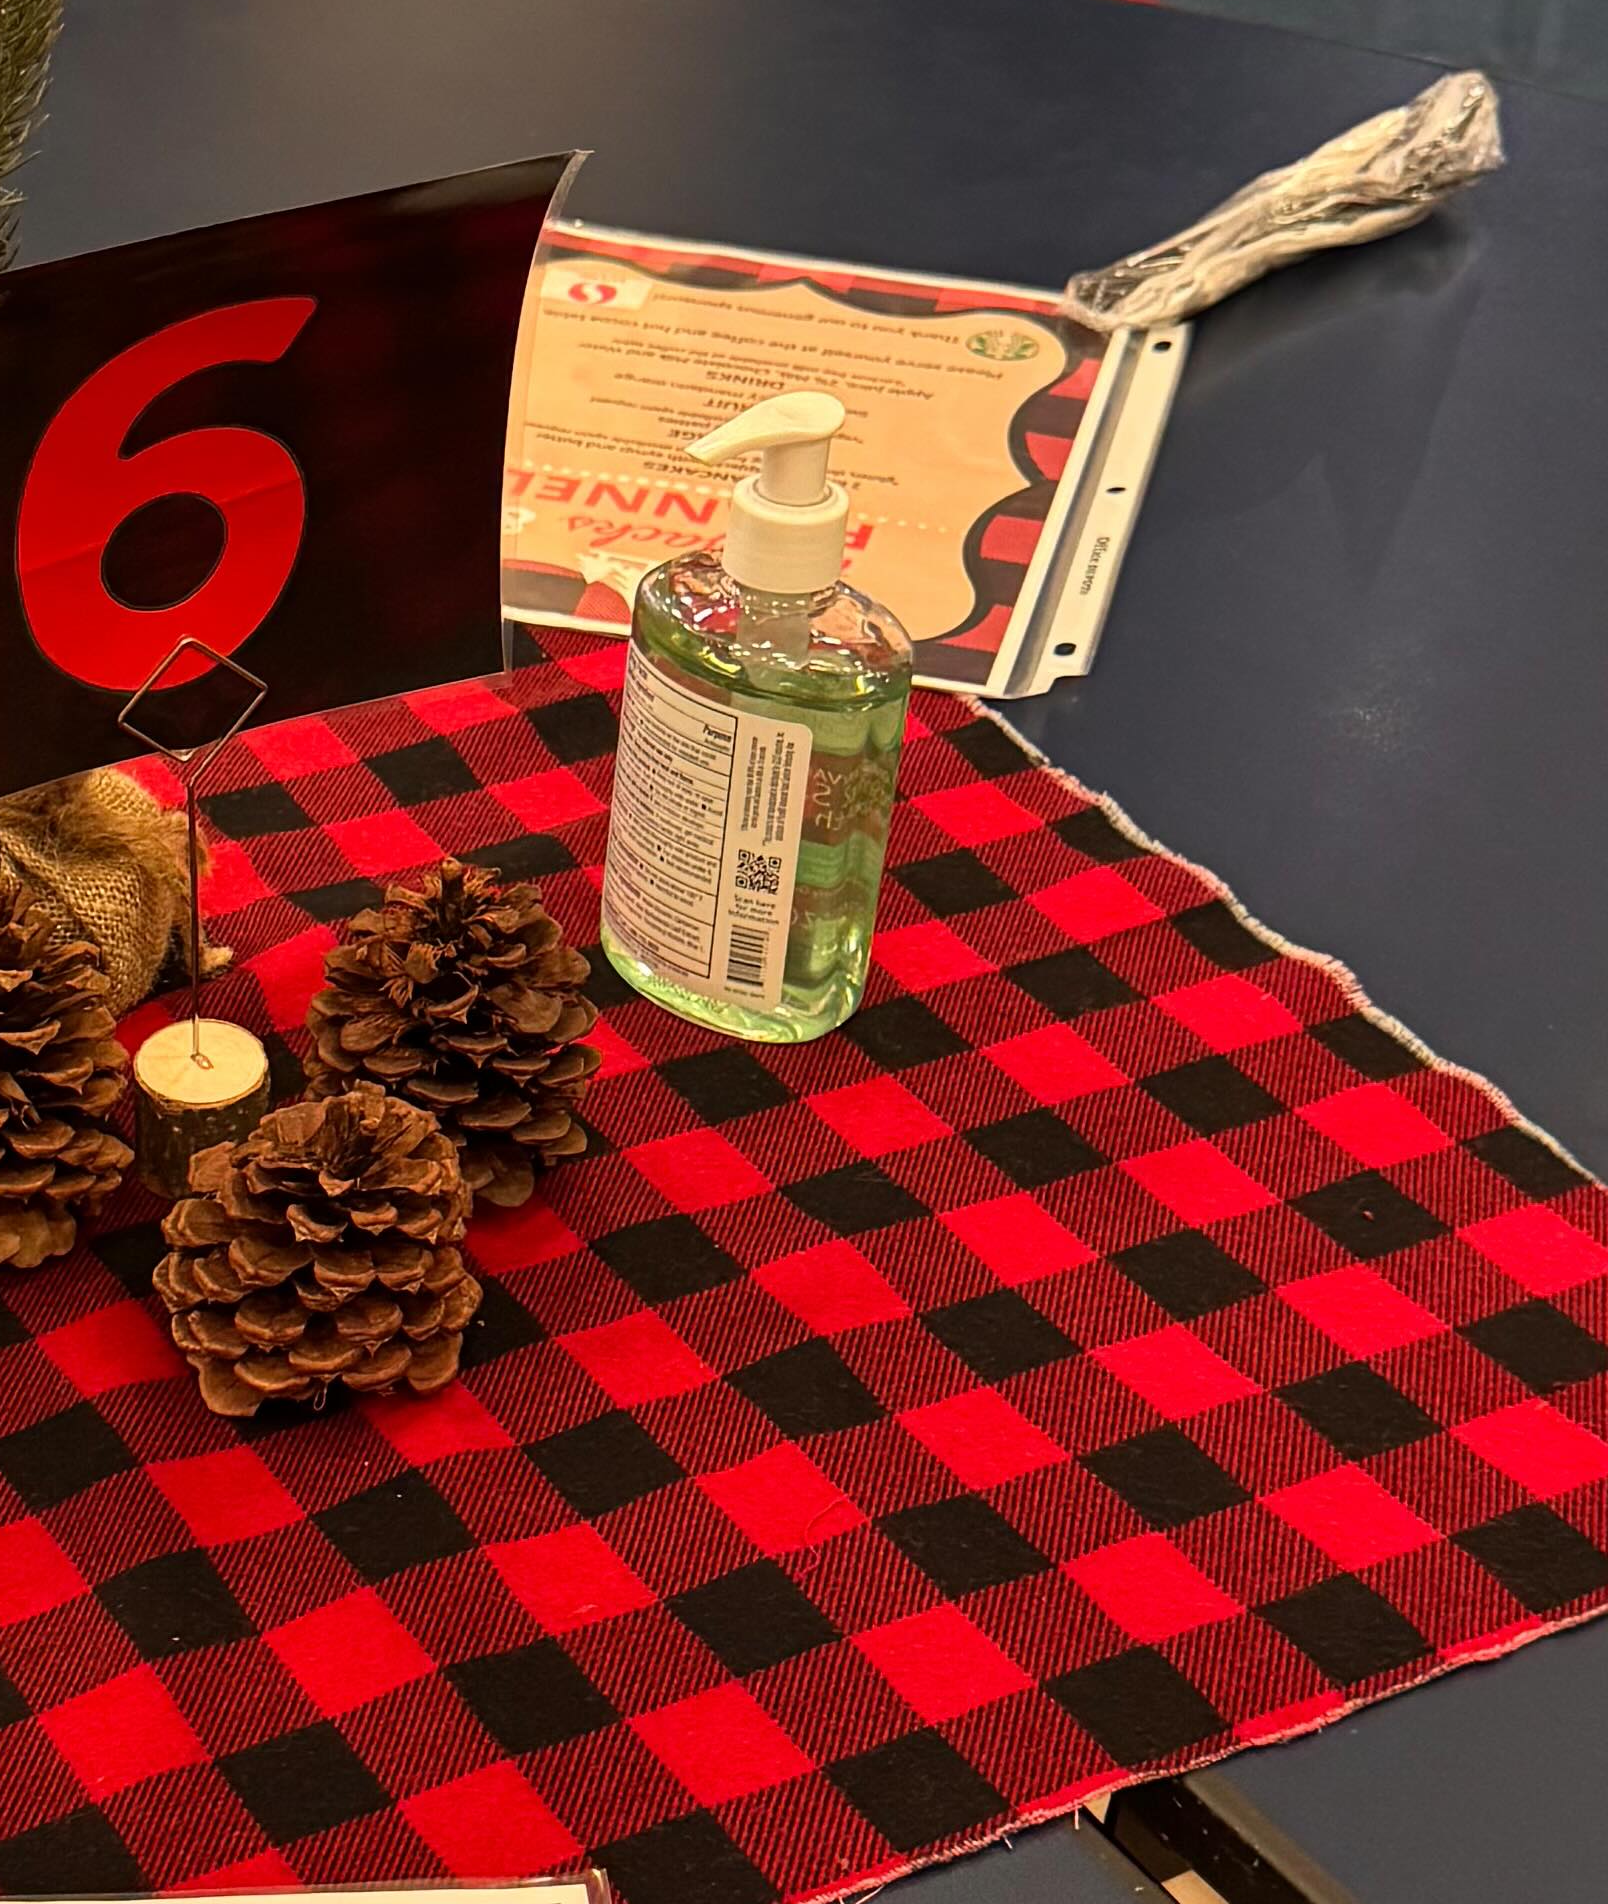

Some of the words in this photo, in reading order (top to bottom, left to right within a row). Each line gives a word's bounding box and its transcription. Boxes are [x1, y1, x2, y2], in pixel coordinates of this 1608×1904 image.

[705, 370, 786, 390] DRINKS
[14, 295, 318, 693] 6
[642, 460, 743, 484] ANCAKES
[506, 468, 874, 551] FNNEL
